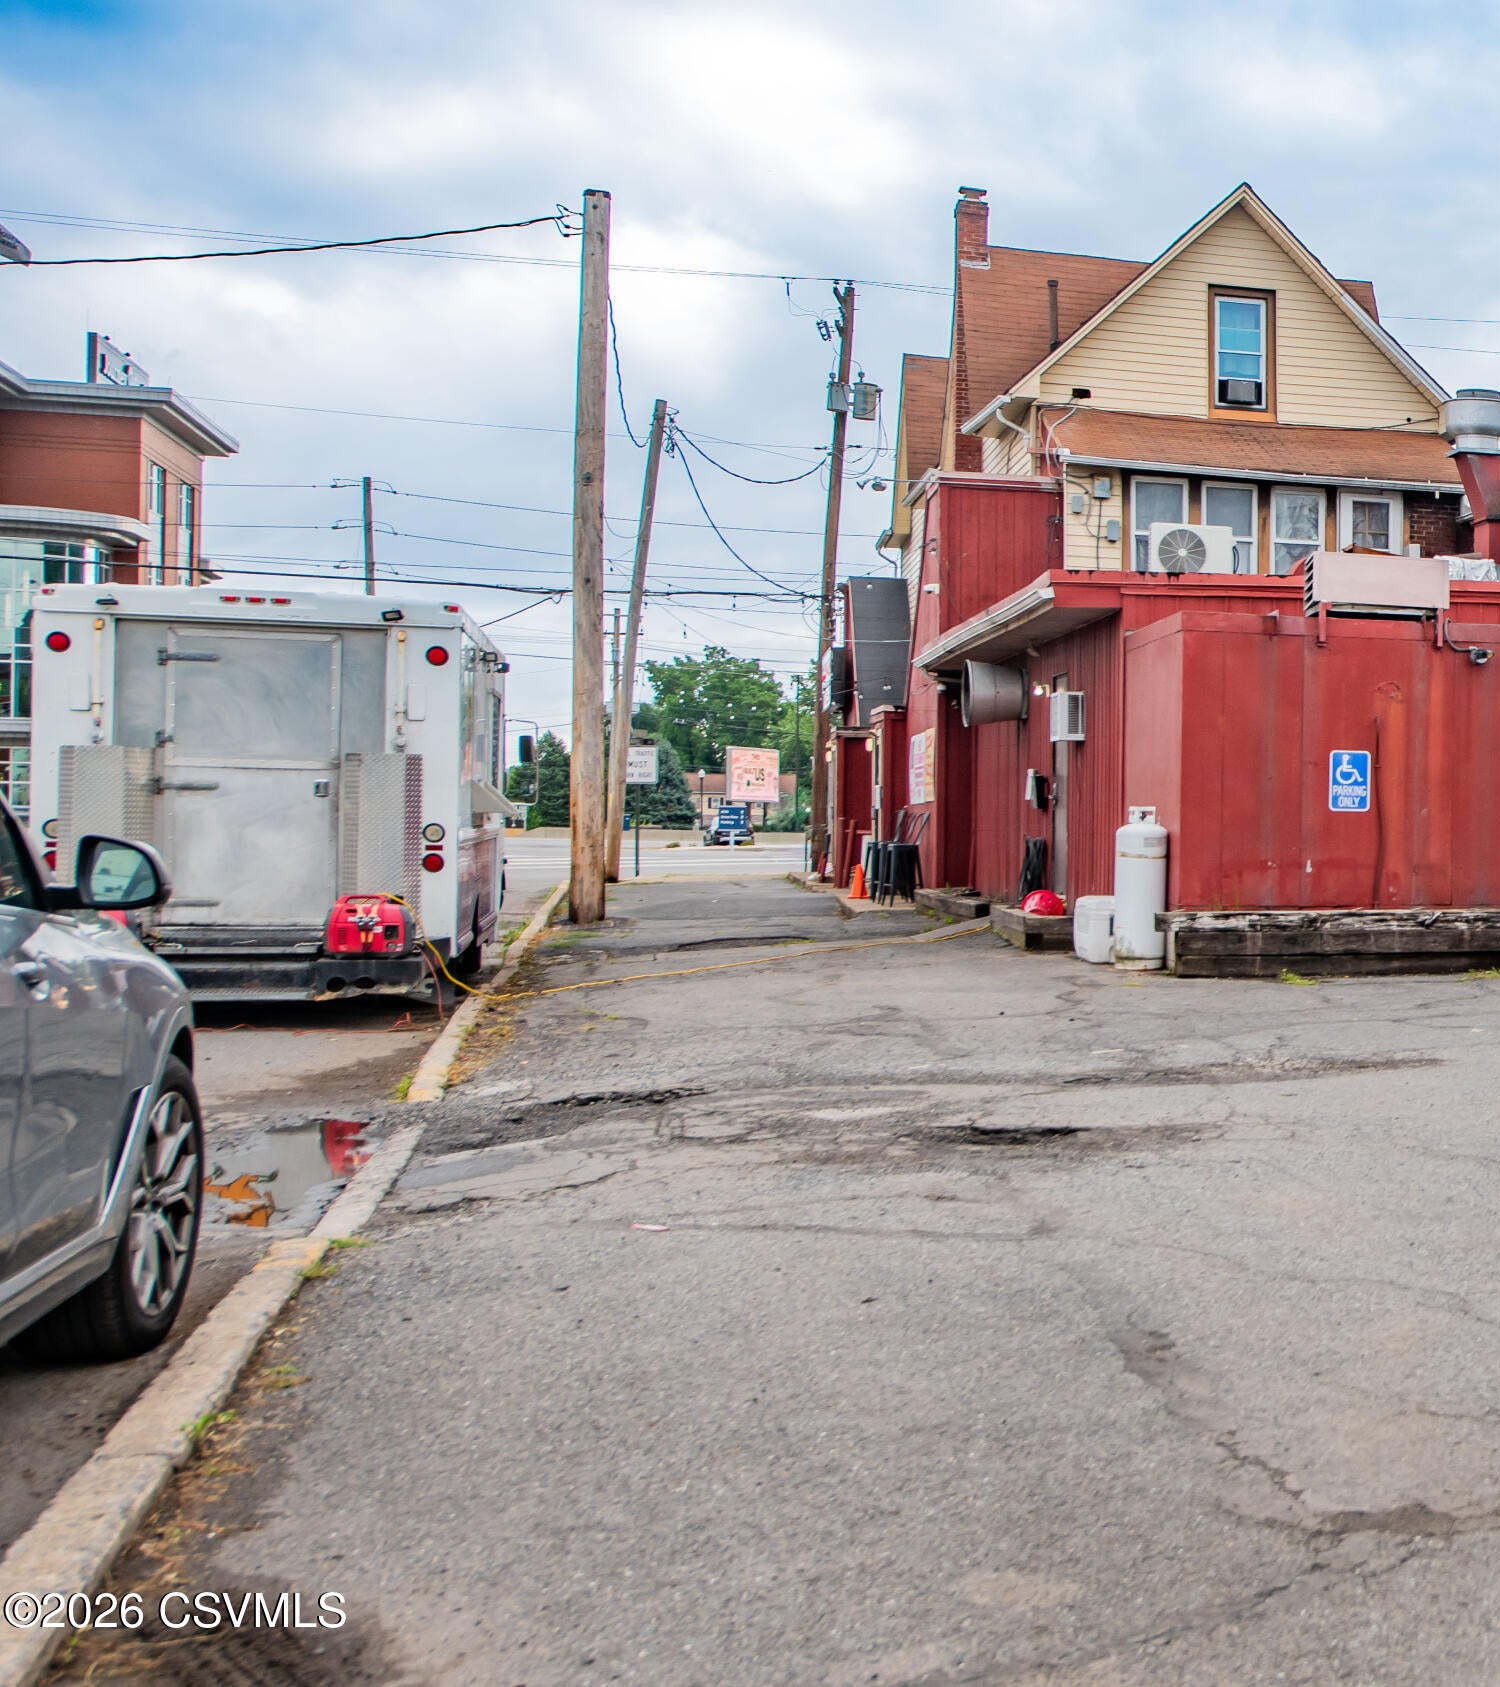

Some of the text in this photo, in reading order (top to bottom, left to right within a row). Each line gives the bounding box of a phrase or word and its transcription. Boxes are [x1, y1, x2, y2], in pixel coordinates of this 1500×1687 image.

[628, 760, 648, 768] MUST
[1332, 785, 1367, 797] PARKING
[1338, 796, 1360, 807] ONLY
